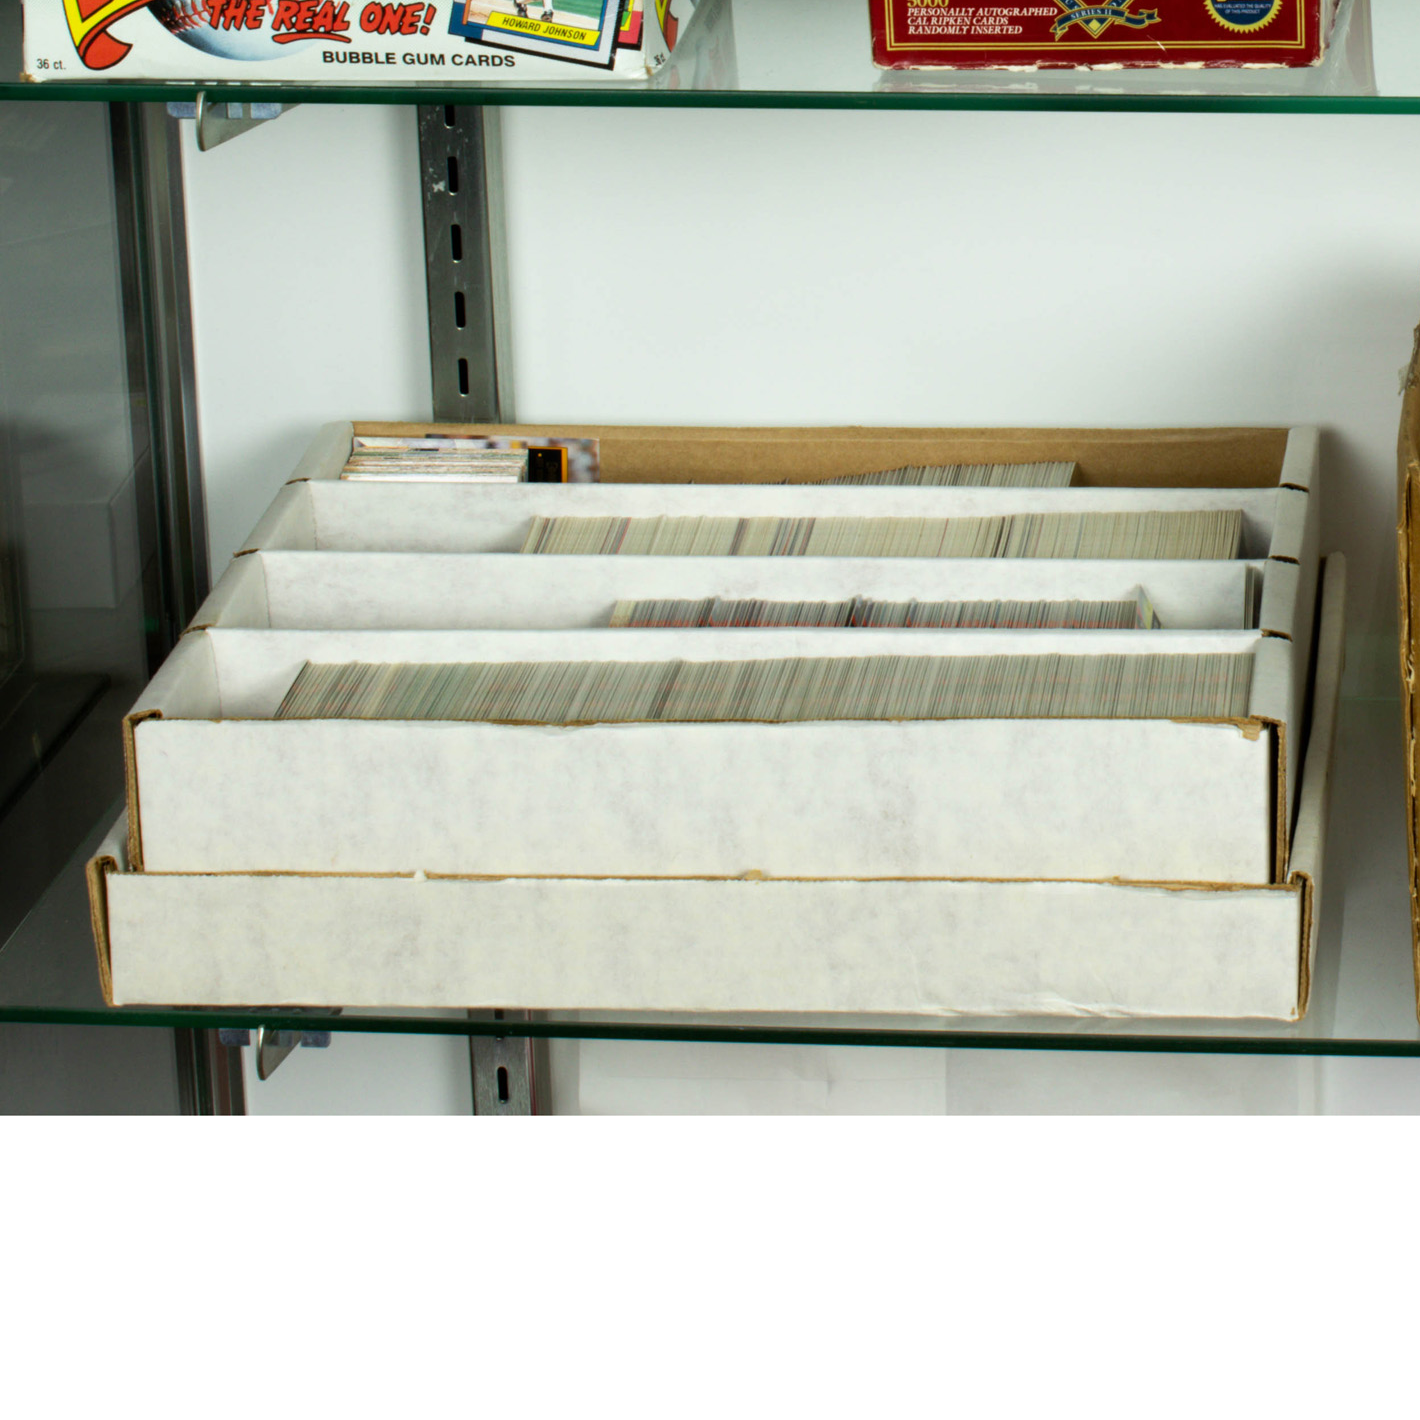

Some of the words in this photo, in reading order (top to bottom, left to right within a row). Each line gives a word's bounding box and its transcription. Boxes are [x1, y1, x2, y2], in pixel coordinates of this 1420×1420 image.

[907, 7, 975, 17] PERSONALLY
[976, 7, 1058, 16] AUTOGRAPHED
[1070, 9, 1102, 19] SERIES
[271, 0, 350, 33] REAL
[359, 2, 437, 36] ONE!
[907, 17, 928, 25] CAL
[930, 17, 972, 25] RIPKEN
[973, 17, 1009, 25] CARDS
[502, 16, 541, 33] HOWARD
[542, 23, 587, 41] JOHNSON
[908, 26, 970, 34] RANDOMLY
[971, 26, 1023, 34] INSERTED
[36, 59, 50, 70] 36
[53, 59, 67, 70] ct.
[322, 51, 396, 65] BUBBLE
[402, 52, 445, 66] GUM
[451, 53, 516, 68] CARDS
